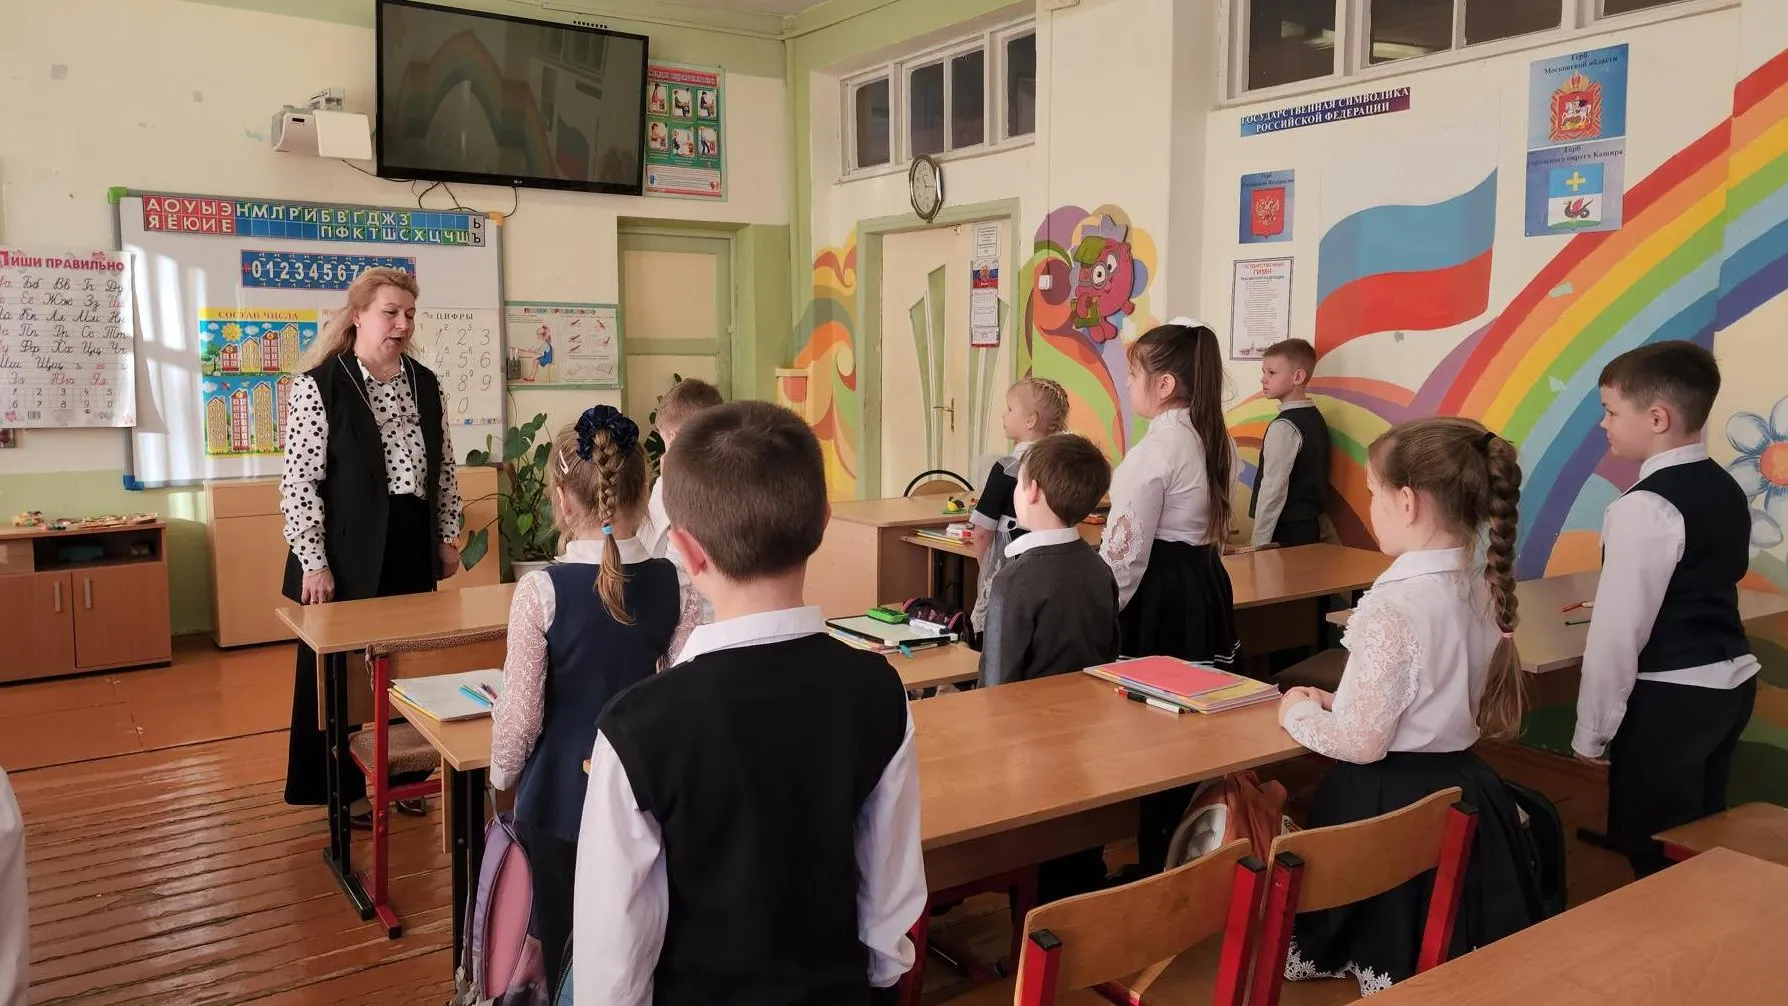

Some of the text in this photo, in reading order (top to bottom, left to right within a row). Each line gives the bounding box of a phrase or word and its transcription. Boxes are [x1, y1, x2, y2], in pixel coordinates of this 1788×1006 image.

[1241, 88, 1409, 125] ГОСУДАРСТВЕННАЯ СИМВОЛИКА
[1256, 102, 1390, 133] РОССИЙСКОЙ ФЕДЕРАЦИИ
[146, 198, 161, 211] А
[164, 199, 180, 213] О
[184, 201, 198, 213] У
[201, 202, 216, 215] Ы
[221, 203, 232, 216] Э
[236, 204, 249, 217] Н
[252, 204, 268, 219] М
[270, 206, 284, 220] Л
[289, 207, 300, 221] Р
[321, 212, 331, 222] Б
[338, 212, 347, 223] В
[367, 213, 379, 226] Д
[382, 213, 395, 225] Ж
[399, 213, 408, 225] З
[473, 219, 481, 229] Ь
[148, 215, 159, 228] Я
[167, 214, 178, 229] Ё
[184, 217, 199, 230] Ю
[203, 218, 216, 231] И
[222, 219, 232, 232] Е
[321, 227, 332, 237] П
[336, 226, 349, 238] Ф
[354, 228, 363, 239] К
[371, 228, 378, 239] Т
[382, 229, 396, 240] Ш
[400, 230, 409, 241] С
[414, 230, 424, 241] Х
[429, 231, 440, 243] Ц
[445, 231, 453, 242] Ч
[473, 233, 481, 243] Ъ
[46, 259, 125, 271] ПРАВИЛЬНО
[252, 261, 261, 278] 0
[266, 261, 273, 278] 1
[280, 262, 290, 279] 2
[295, 263, 304, 280] 3
[309, 263, 318, 280] 4
[323, 264, 332, 281] 5
[337, 264, 346, 281] 6
[350, 265, 360, 280] 7
[457, 329, 467, 345] 2
[481, 329, 490, 345] 3
[435, 352, 444, 368] 4
[458, 352, 467, 368] 5
[480, 352, 491, 368] 6
[458, 375, 468, 391] 8
[481, 374, 491, 391] 9
[458, 397, 468, 414] 0
